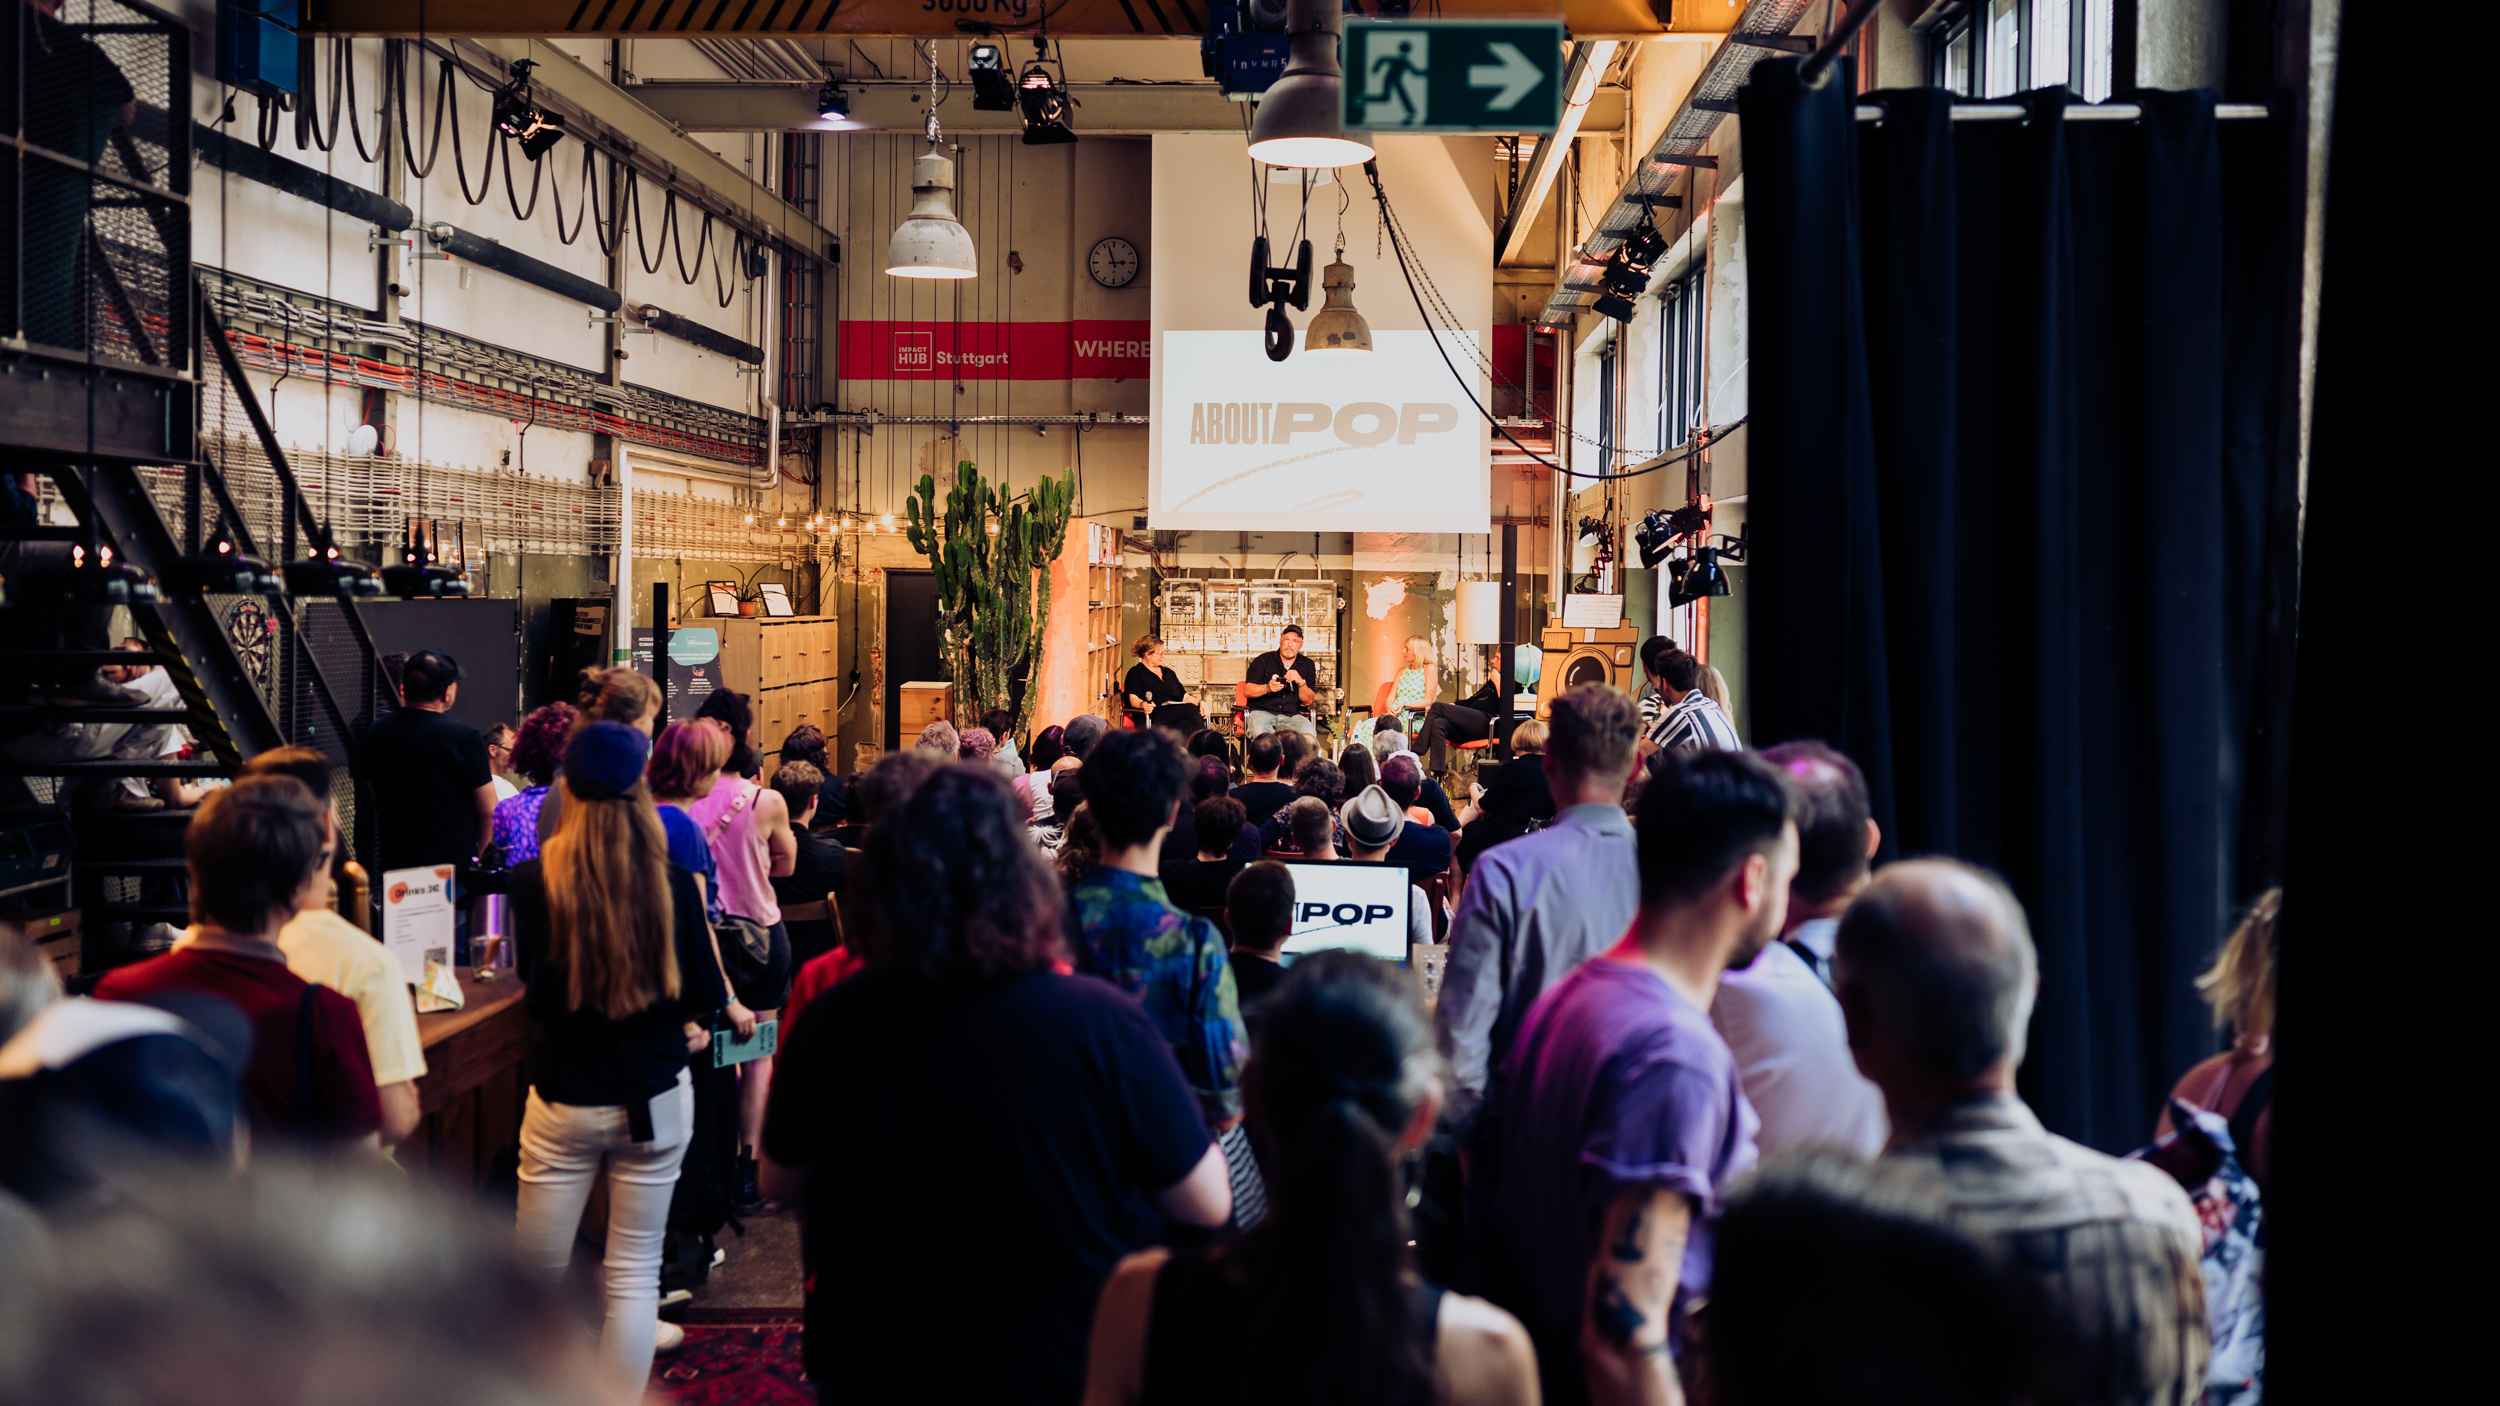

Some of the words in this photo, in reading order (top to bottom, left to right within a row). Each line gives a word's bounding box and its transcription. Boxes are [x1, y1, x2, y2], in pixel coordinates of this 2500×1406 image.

[1074, 340, 1150, 358] WHERE
[898, 353, 928, 364] HUB
[936, 351, 1009, 368] Stuttgart
